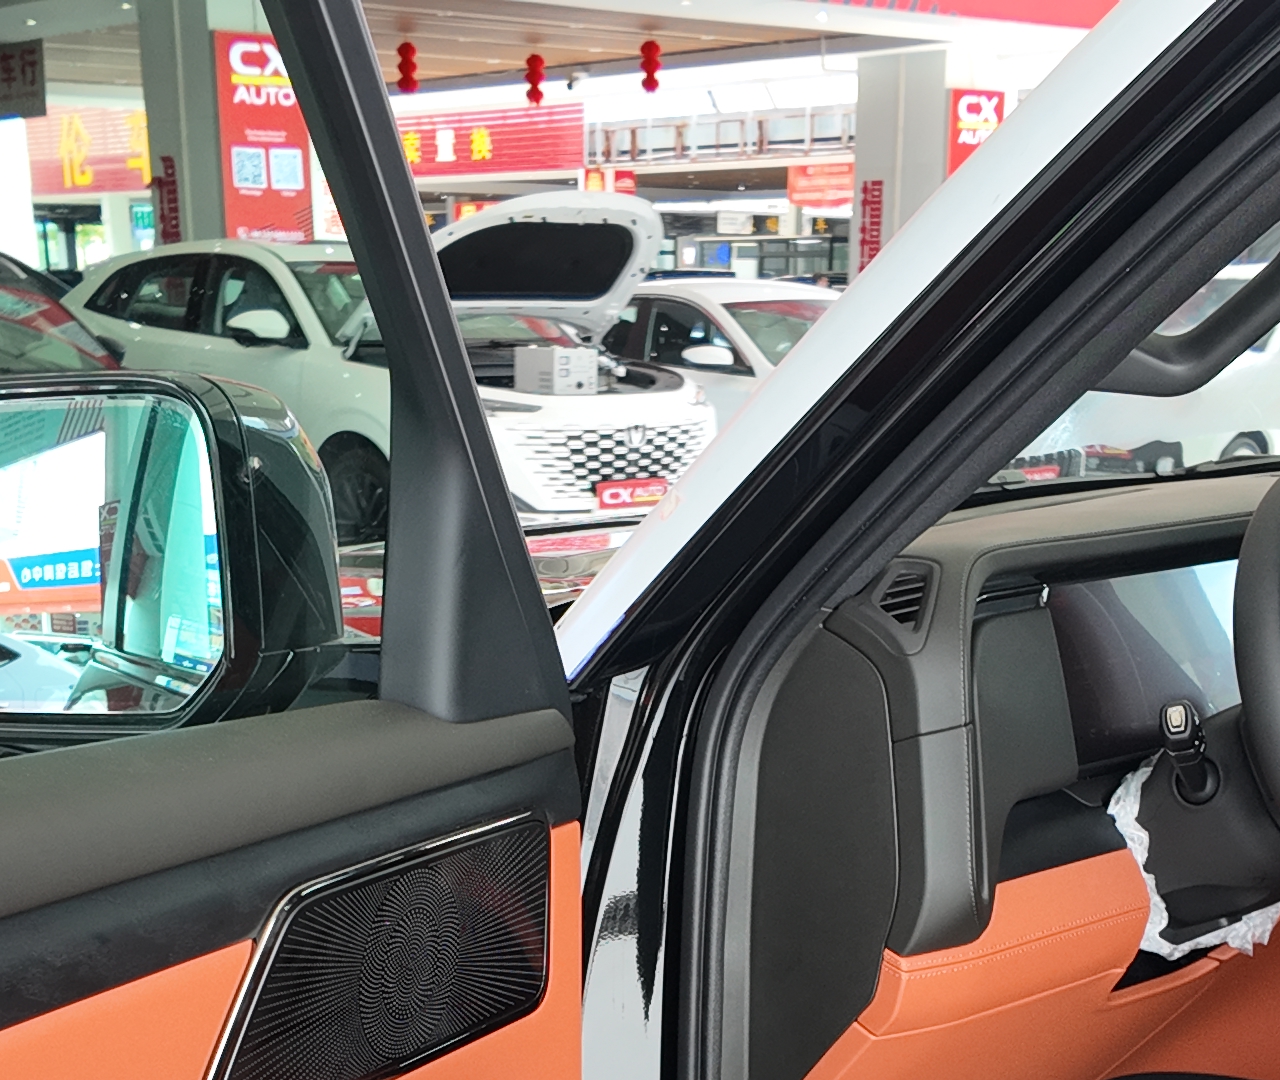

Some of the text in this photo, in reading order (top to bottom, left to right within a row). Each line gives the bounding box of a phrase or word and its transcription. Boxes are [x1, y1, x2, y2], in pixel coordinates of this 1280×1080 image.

[229, 41, 288, 77] CX
[233, 84, 297, 107] AUTO
[958, 94, 999, 122] CX
[602, 487, 633, 504] CX
